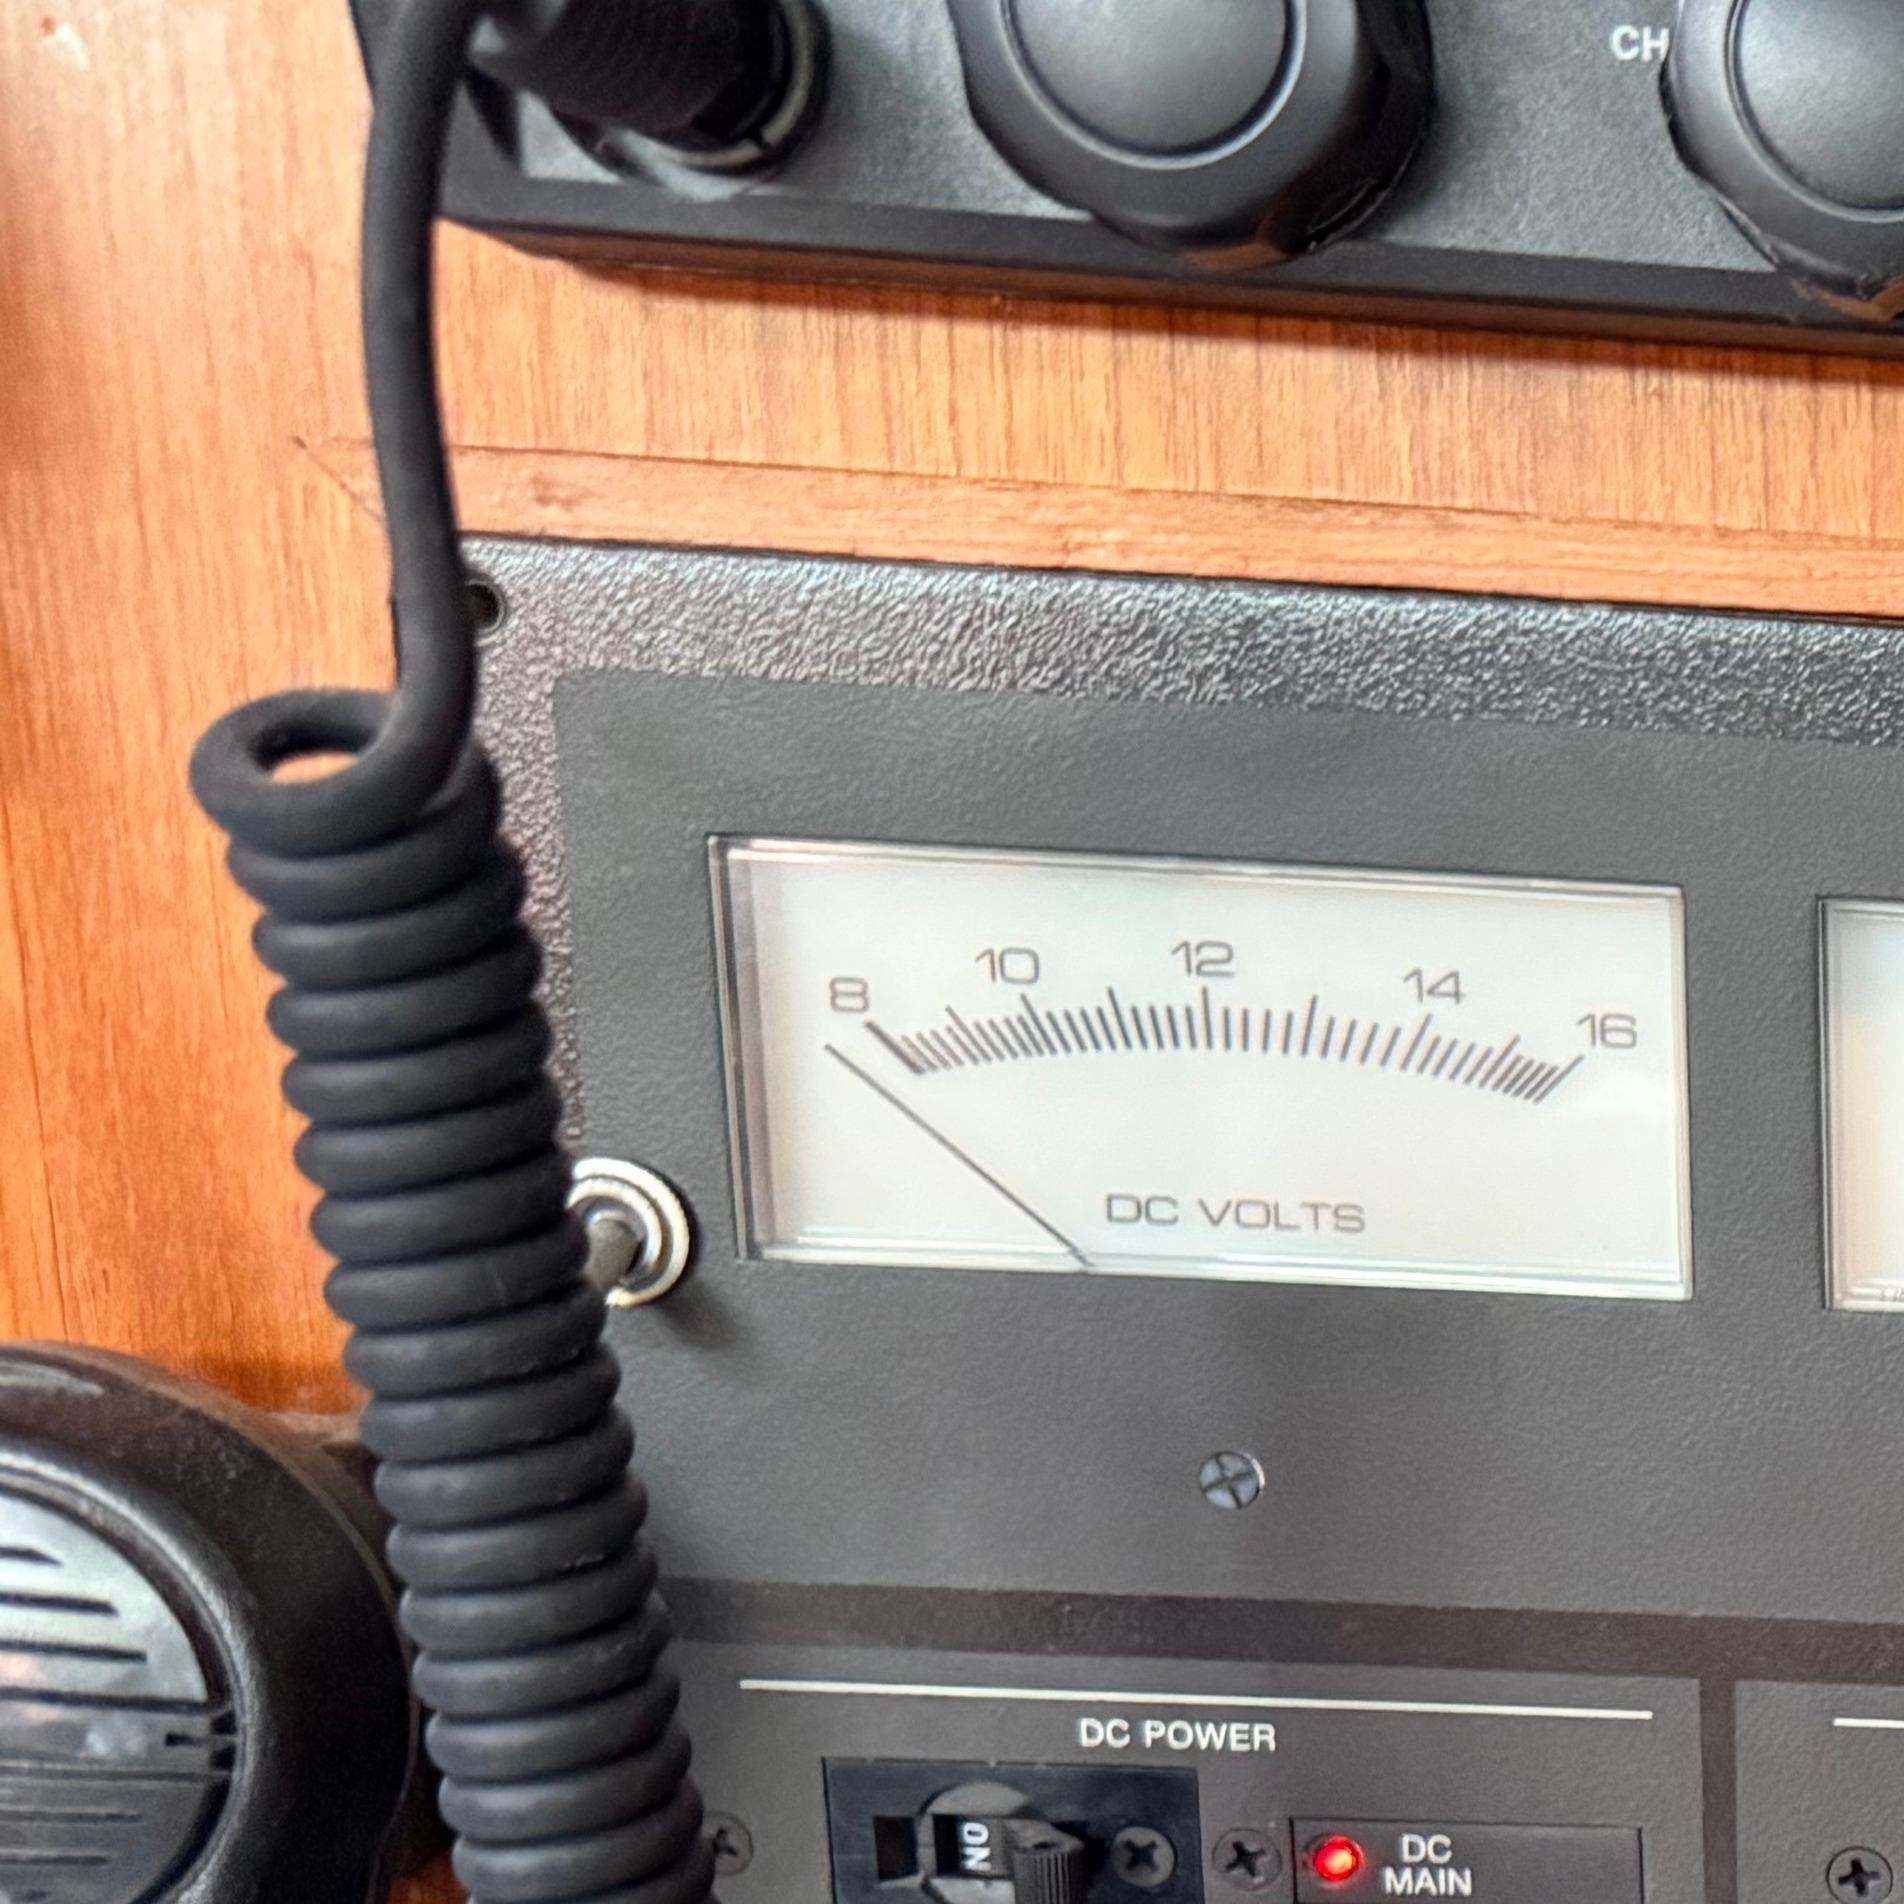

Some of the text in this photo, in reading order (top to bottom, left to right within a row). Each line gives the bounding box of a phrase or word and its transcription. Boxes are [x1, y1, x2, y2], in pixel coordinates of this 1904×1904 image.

[974, 946, 1039, 985] 10
[1170, 941, 1235, 978] 12
[830, 977, 871, 1013] 8
[1403, 968, 1467, 1005] 14
[1576, 1012, 1637, 1050] 16
[1106, 1193, 1366, 1233] DC VOLTS
[1078, 1718, 1277, 1752] DC POWER
[960, 1822, 990, 1873] ON
[1402, 1833, 1452, 1864] DC
[1383, 1865, 1472, 1897] MAIN
